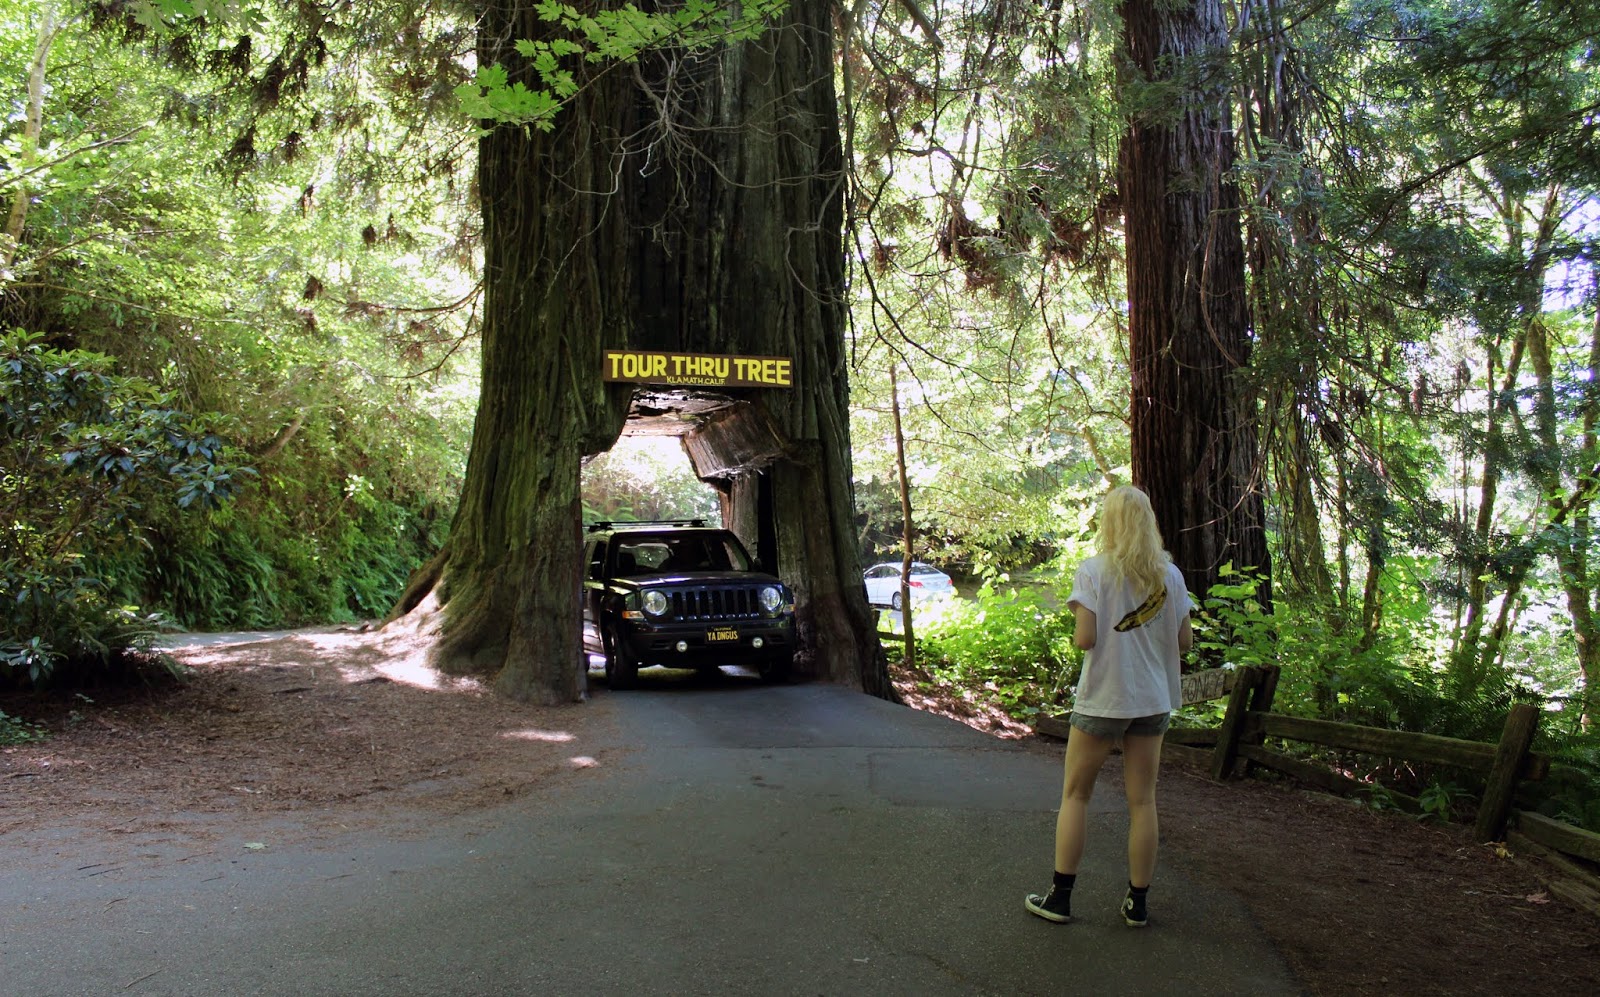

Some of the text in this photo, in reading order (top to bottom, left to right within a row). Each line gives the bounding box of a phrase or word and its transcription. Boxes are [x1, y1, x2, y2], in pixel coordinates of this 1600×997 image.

[608, 353, 790, 385] TOUR THRU TREE
[707, 632, 716, 641] YA
